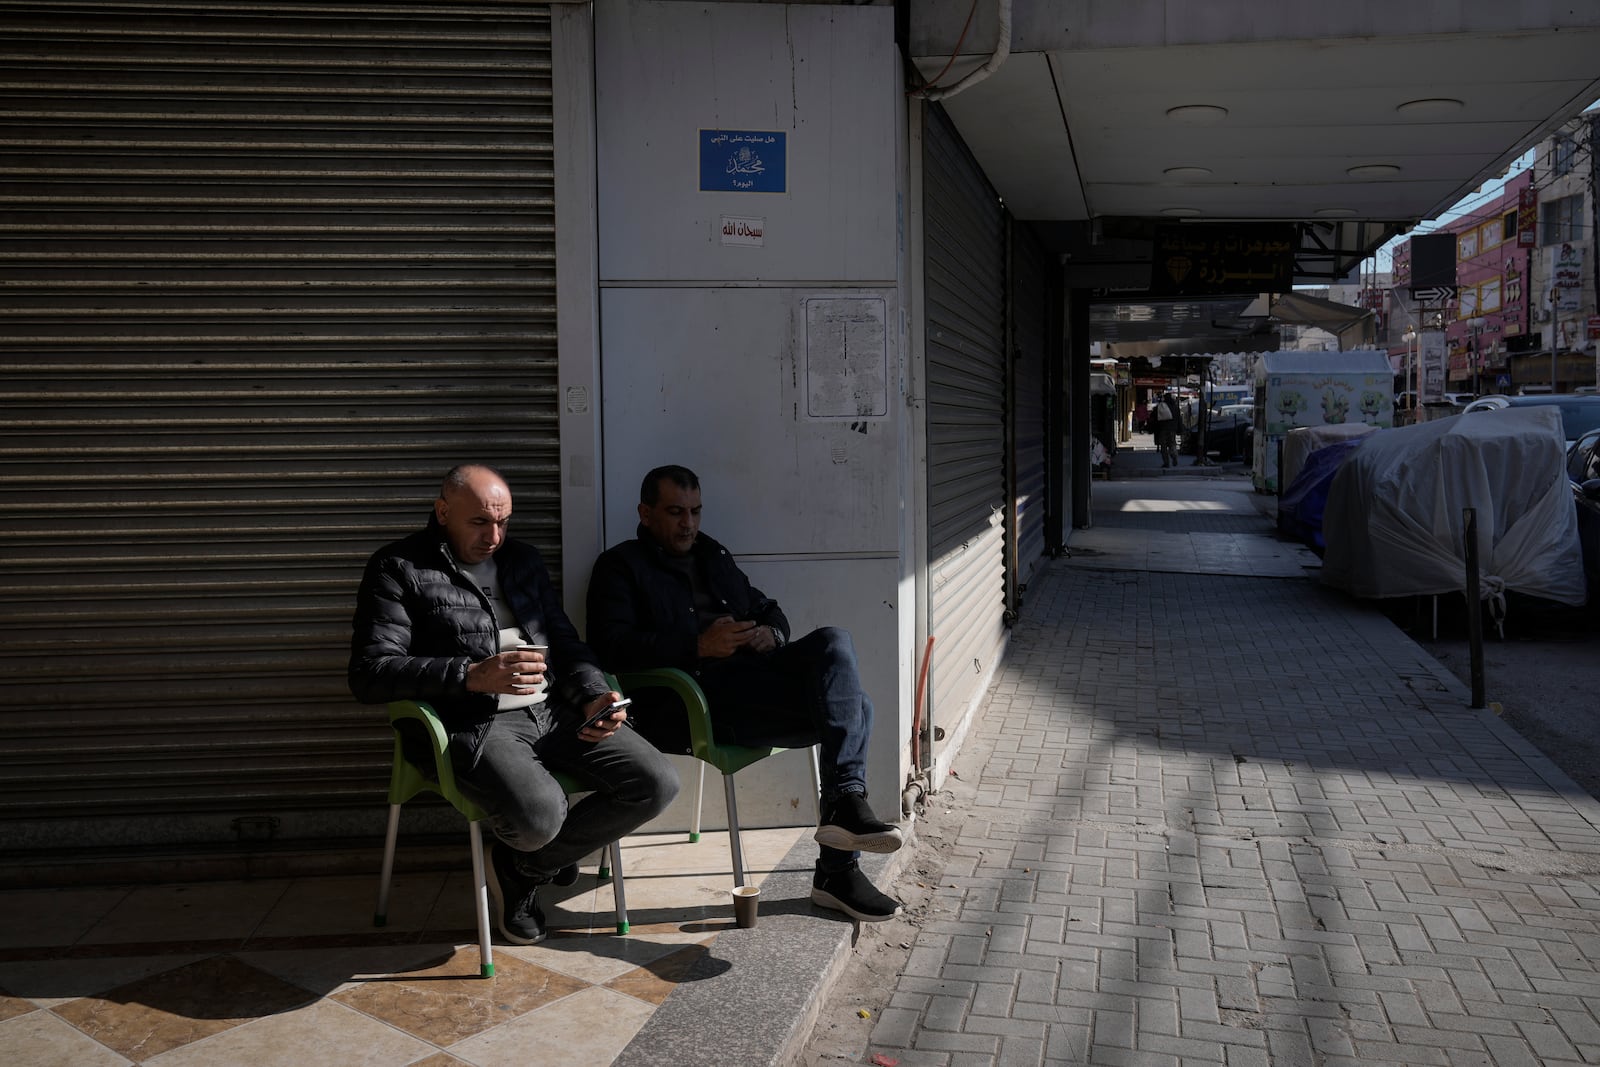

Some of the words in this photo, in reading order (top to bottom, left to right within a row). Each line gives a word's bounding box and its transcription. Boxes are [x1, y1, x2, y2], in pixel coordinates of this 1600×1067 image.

[710, 134, 728, 145] النبي
[729, 135, 743, 143] على
[744, 135, 764, 144] صليت
[764, 135, 776, 143] هل
[722, 221, 736, 236] الله
[737, 222, 763, 240] سبحان
